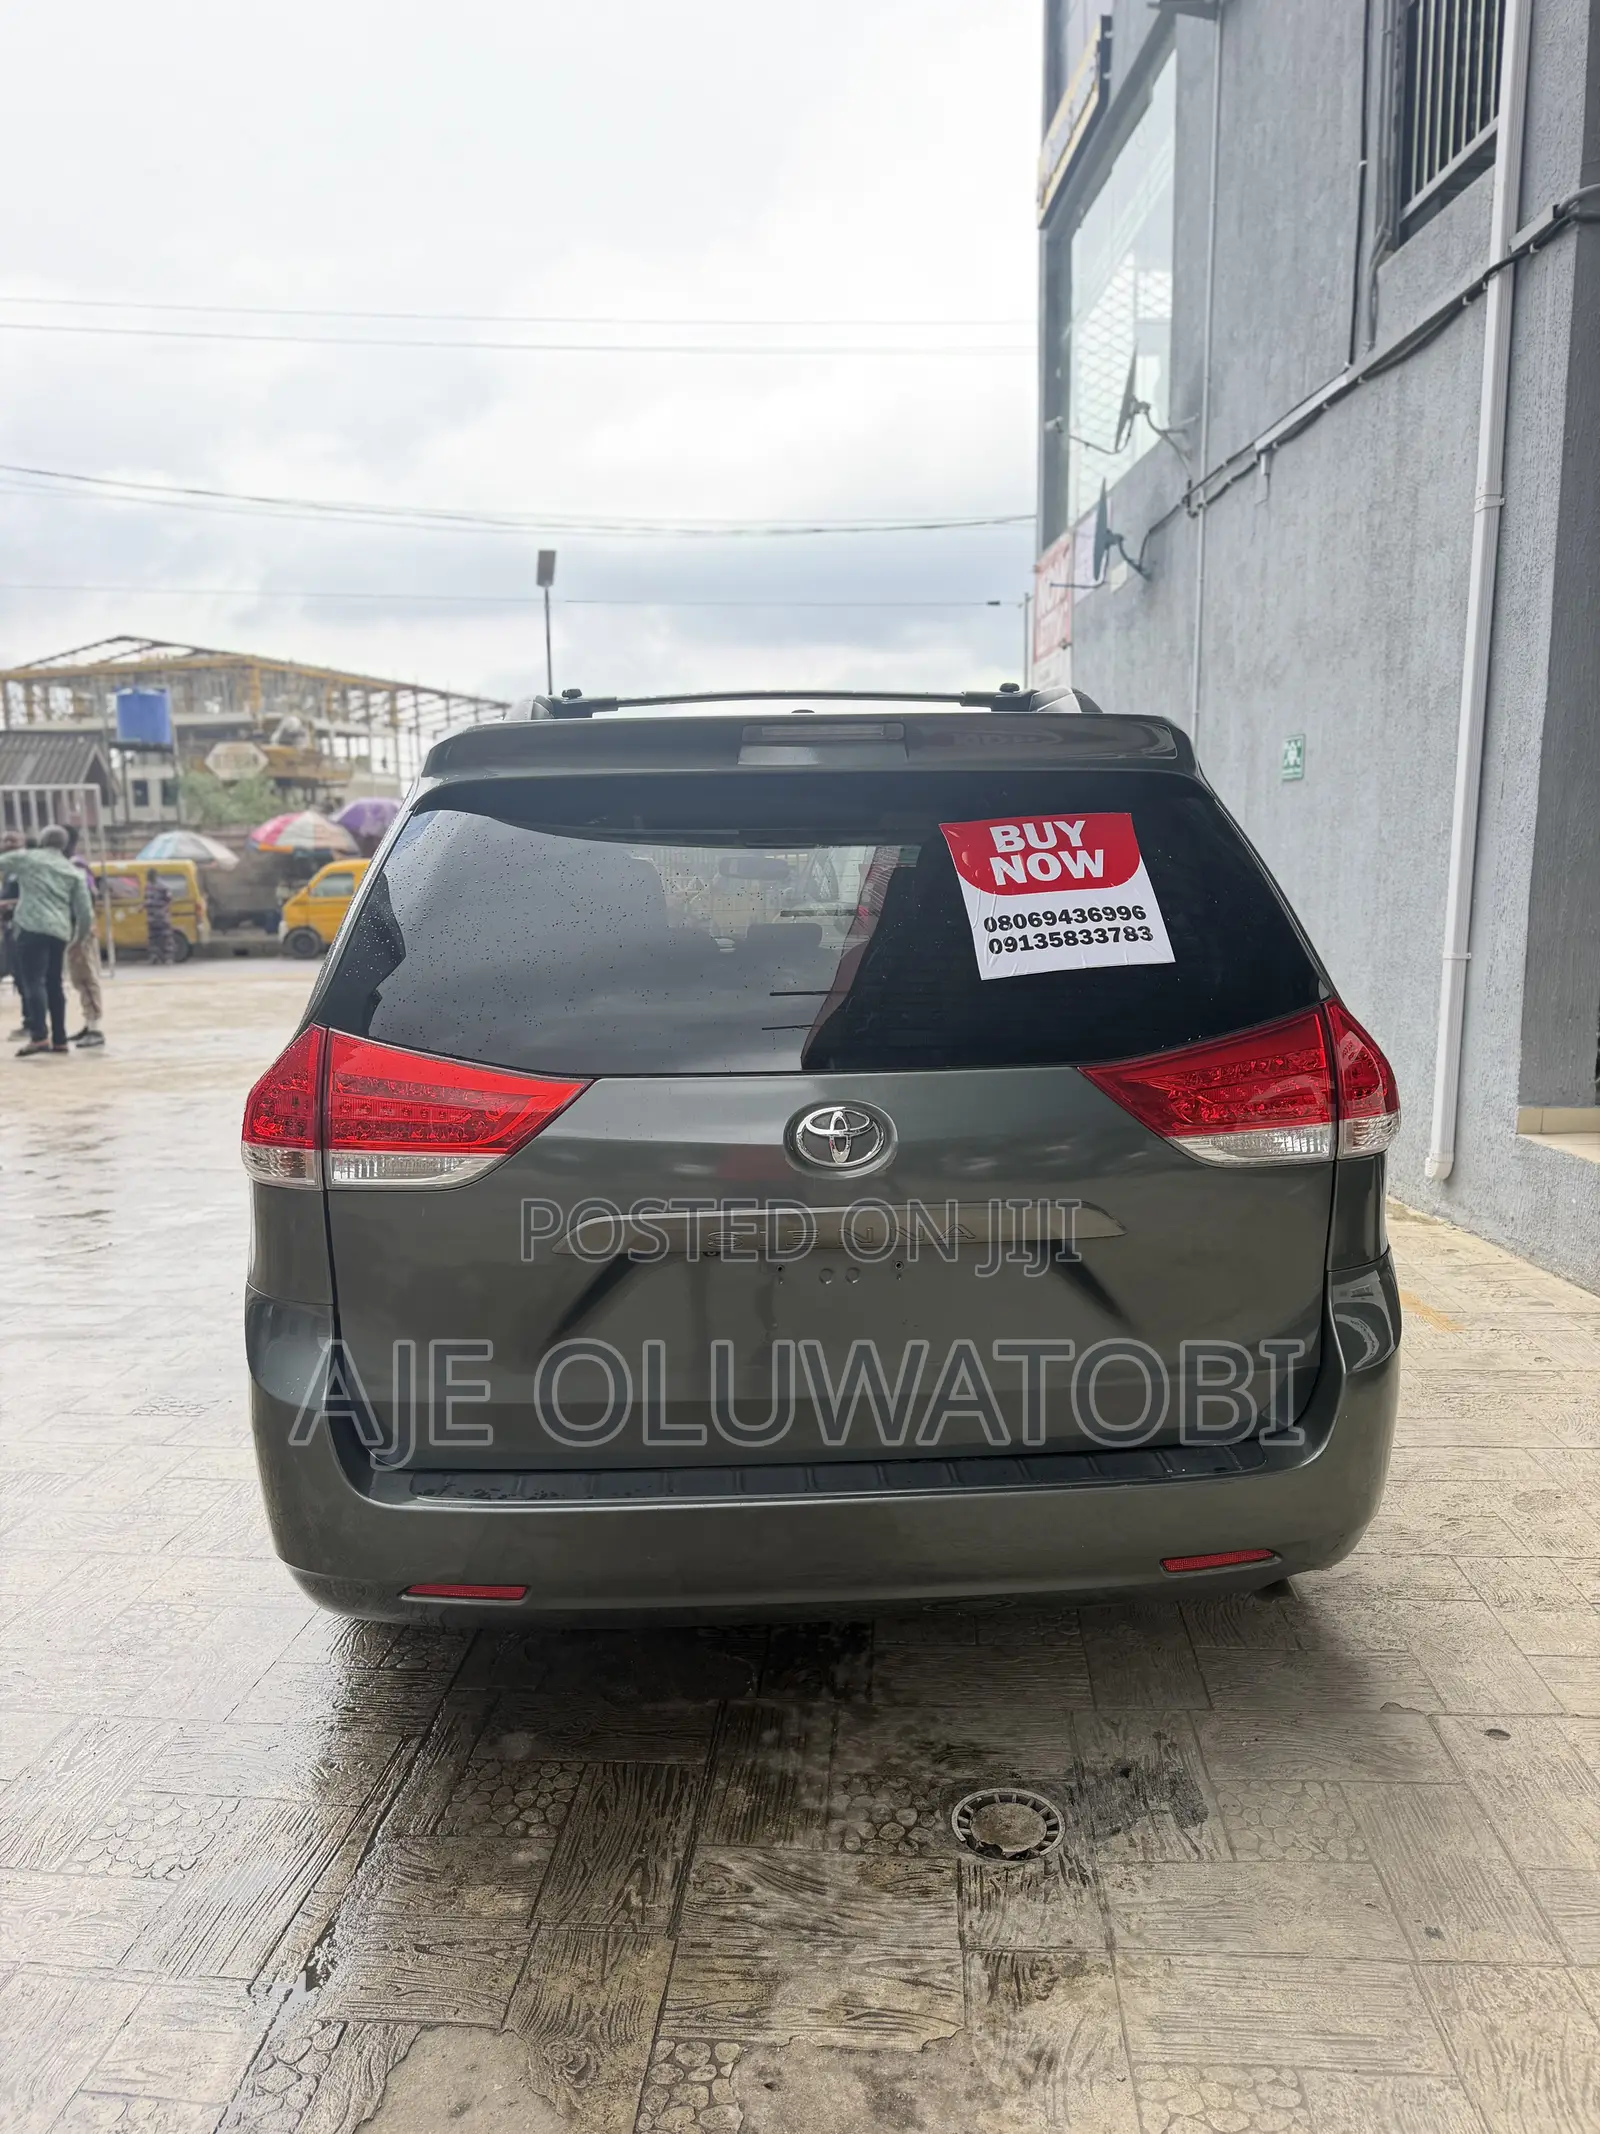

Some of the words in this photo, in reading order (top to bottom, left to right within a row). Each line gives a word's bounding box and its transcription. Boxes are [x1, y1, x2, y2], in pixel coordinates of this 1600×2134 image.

[989, 820, 1086, 853] BUY
[989, 849, 1104, 886] NOW
[983, 904, 1147, 933] 08069436996
[988, 925, 1154, 955] 09135833783
